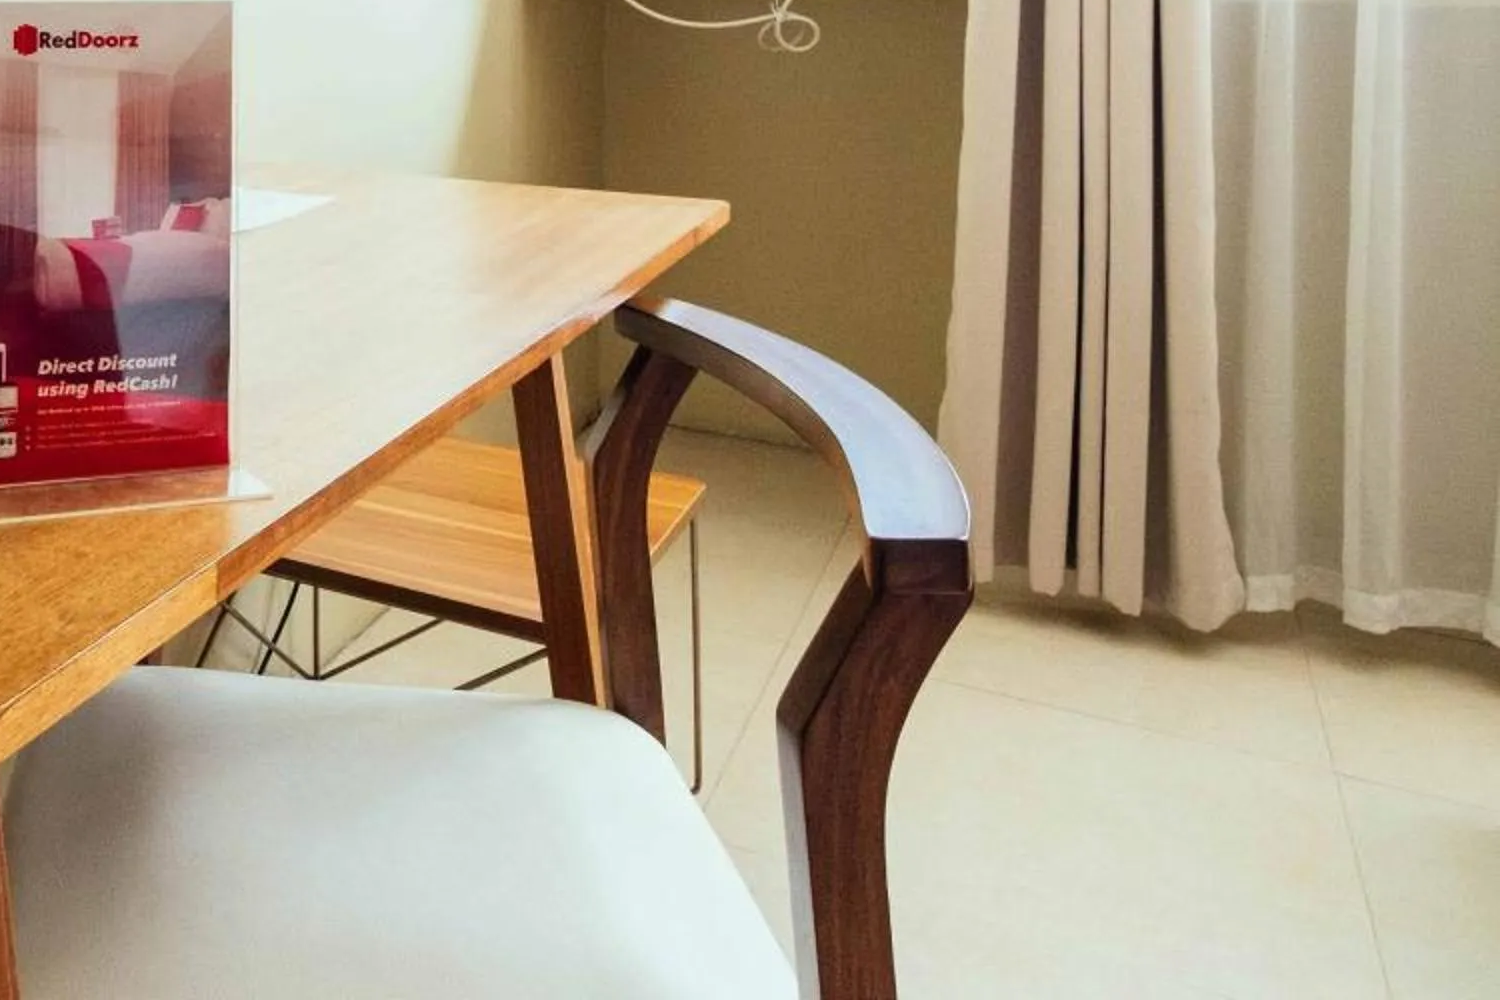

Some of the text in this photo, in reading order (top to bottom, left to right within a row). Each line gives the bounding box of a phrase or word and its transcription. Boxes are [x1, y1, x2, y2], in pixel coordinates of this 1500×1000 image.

[39, 30, 139, 49] RedDoorz
[38, 354, 177, 375] Direct Discount
[38, 373, 178, 399] using RedCash!
